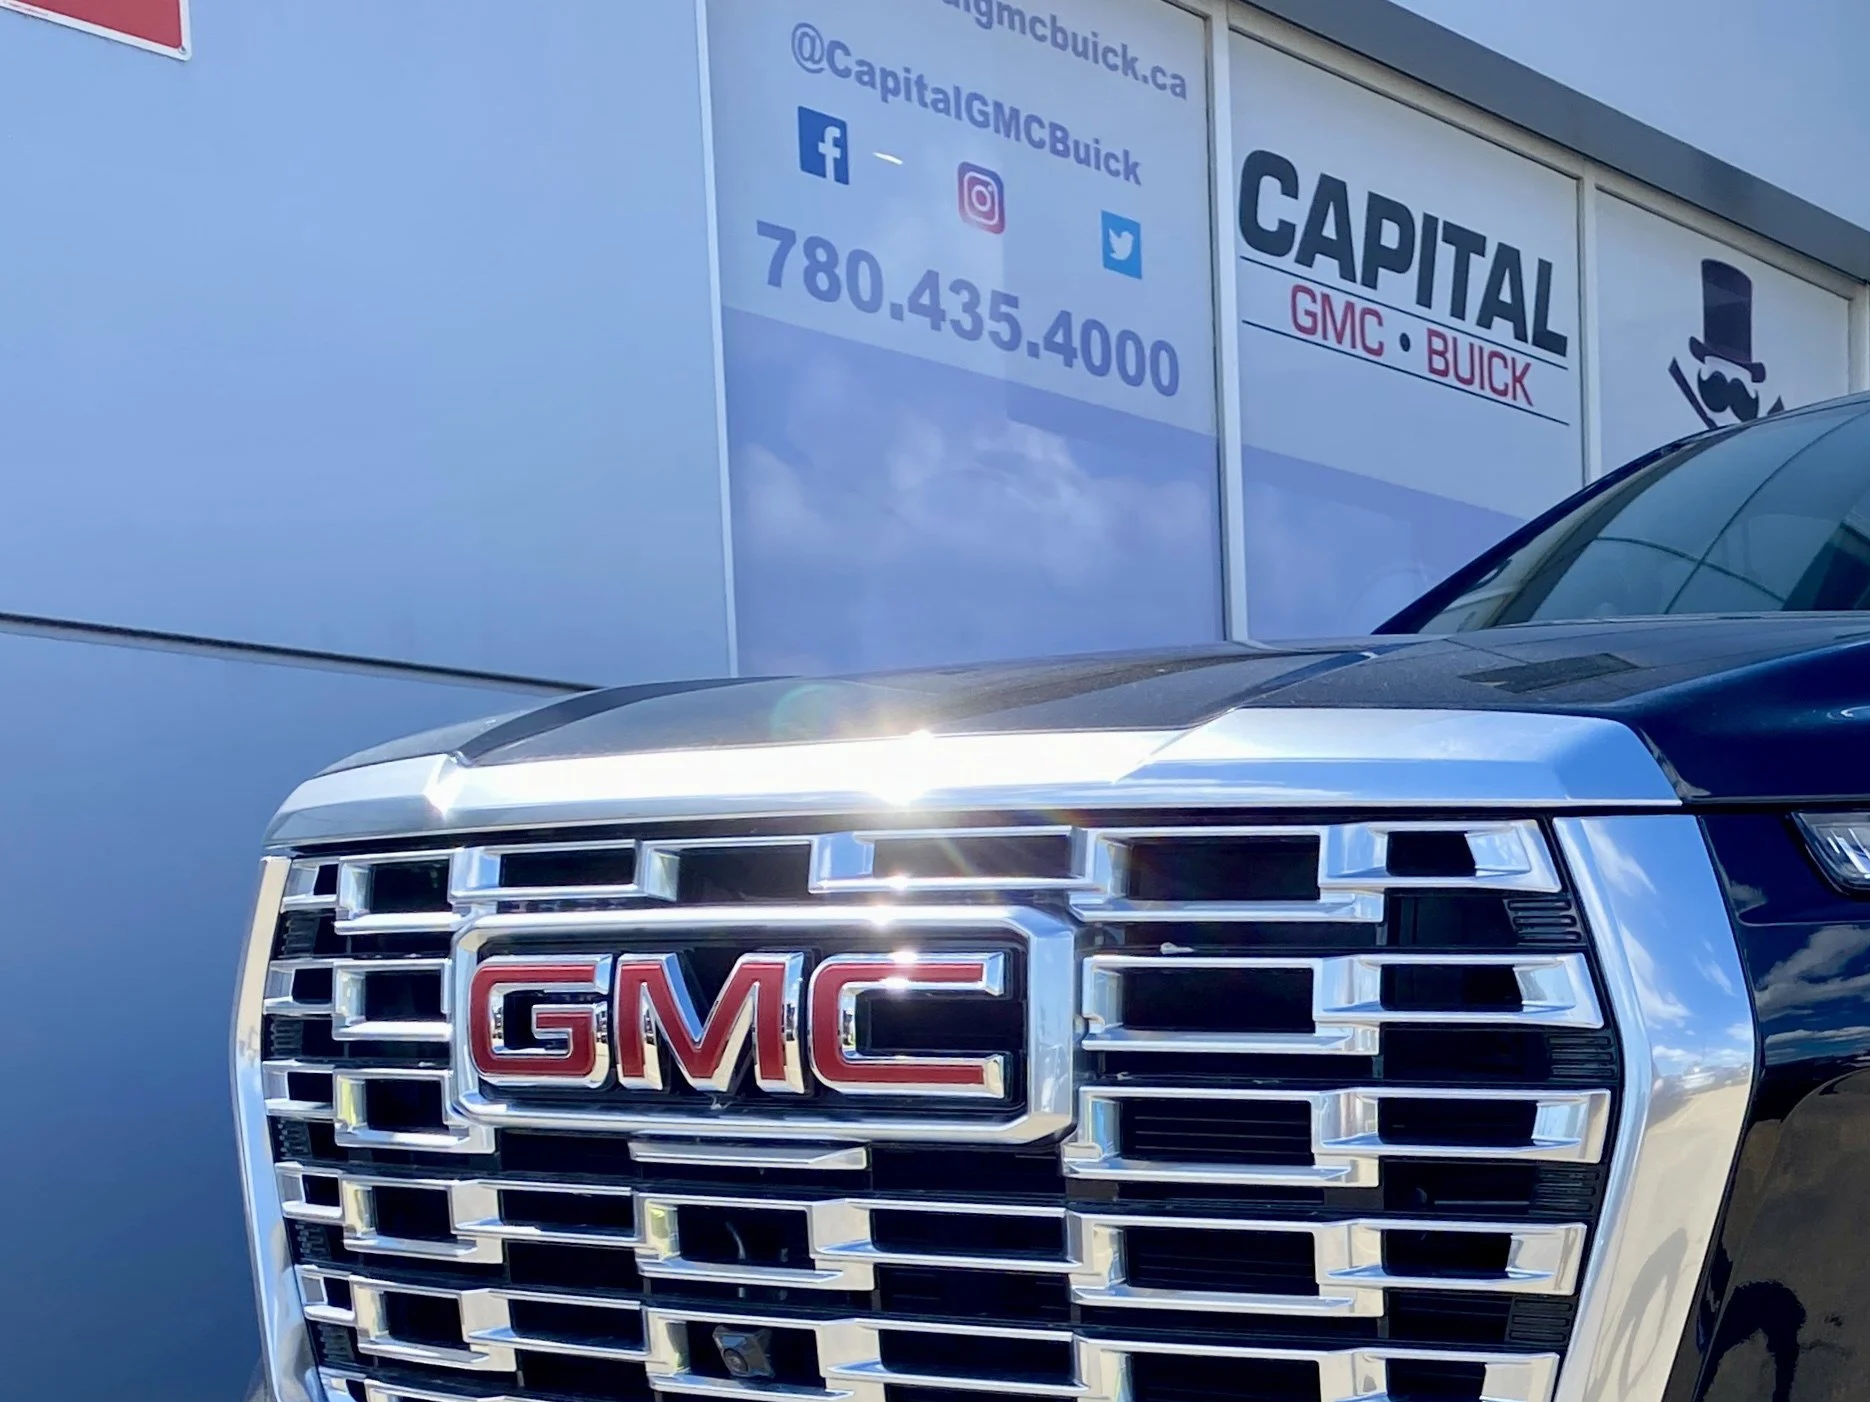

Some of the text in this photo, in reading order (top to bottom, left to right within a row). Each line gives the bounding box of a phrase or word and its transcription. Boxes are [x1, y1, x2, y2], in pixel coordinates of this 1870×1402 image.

[791, 22, 1142, 186] @CapitalGMCBuick
[942, 0, 1187, 99] gmcbuick.ca
[756, 219, 1181, 397] 780.435.4000
[1239, 150, 1569, 359] CAPITAL
[1291, 284, 1534, 408] GMC BUICK
[467, 951, 1005, 1099] GMC
